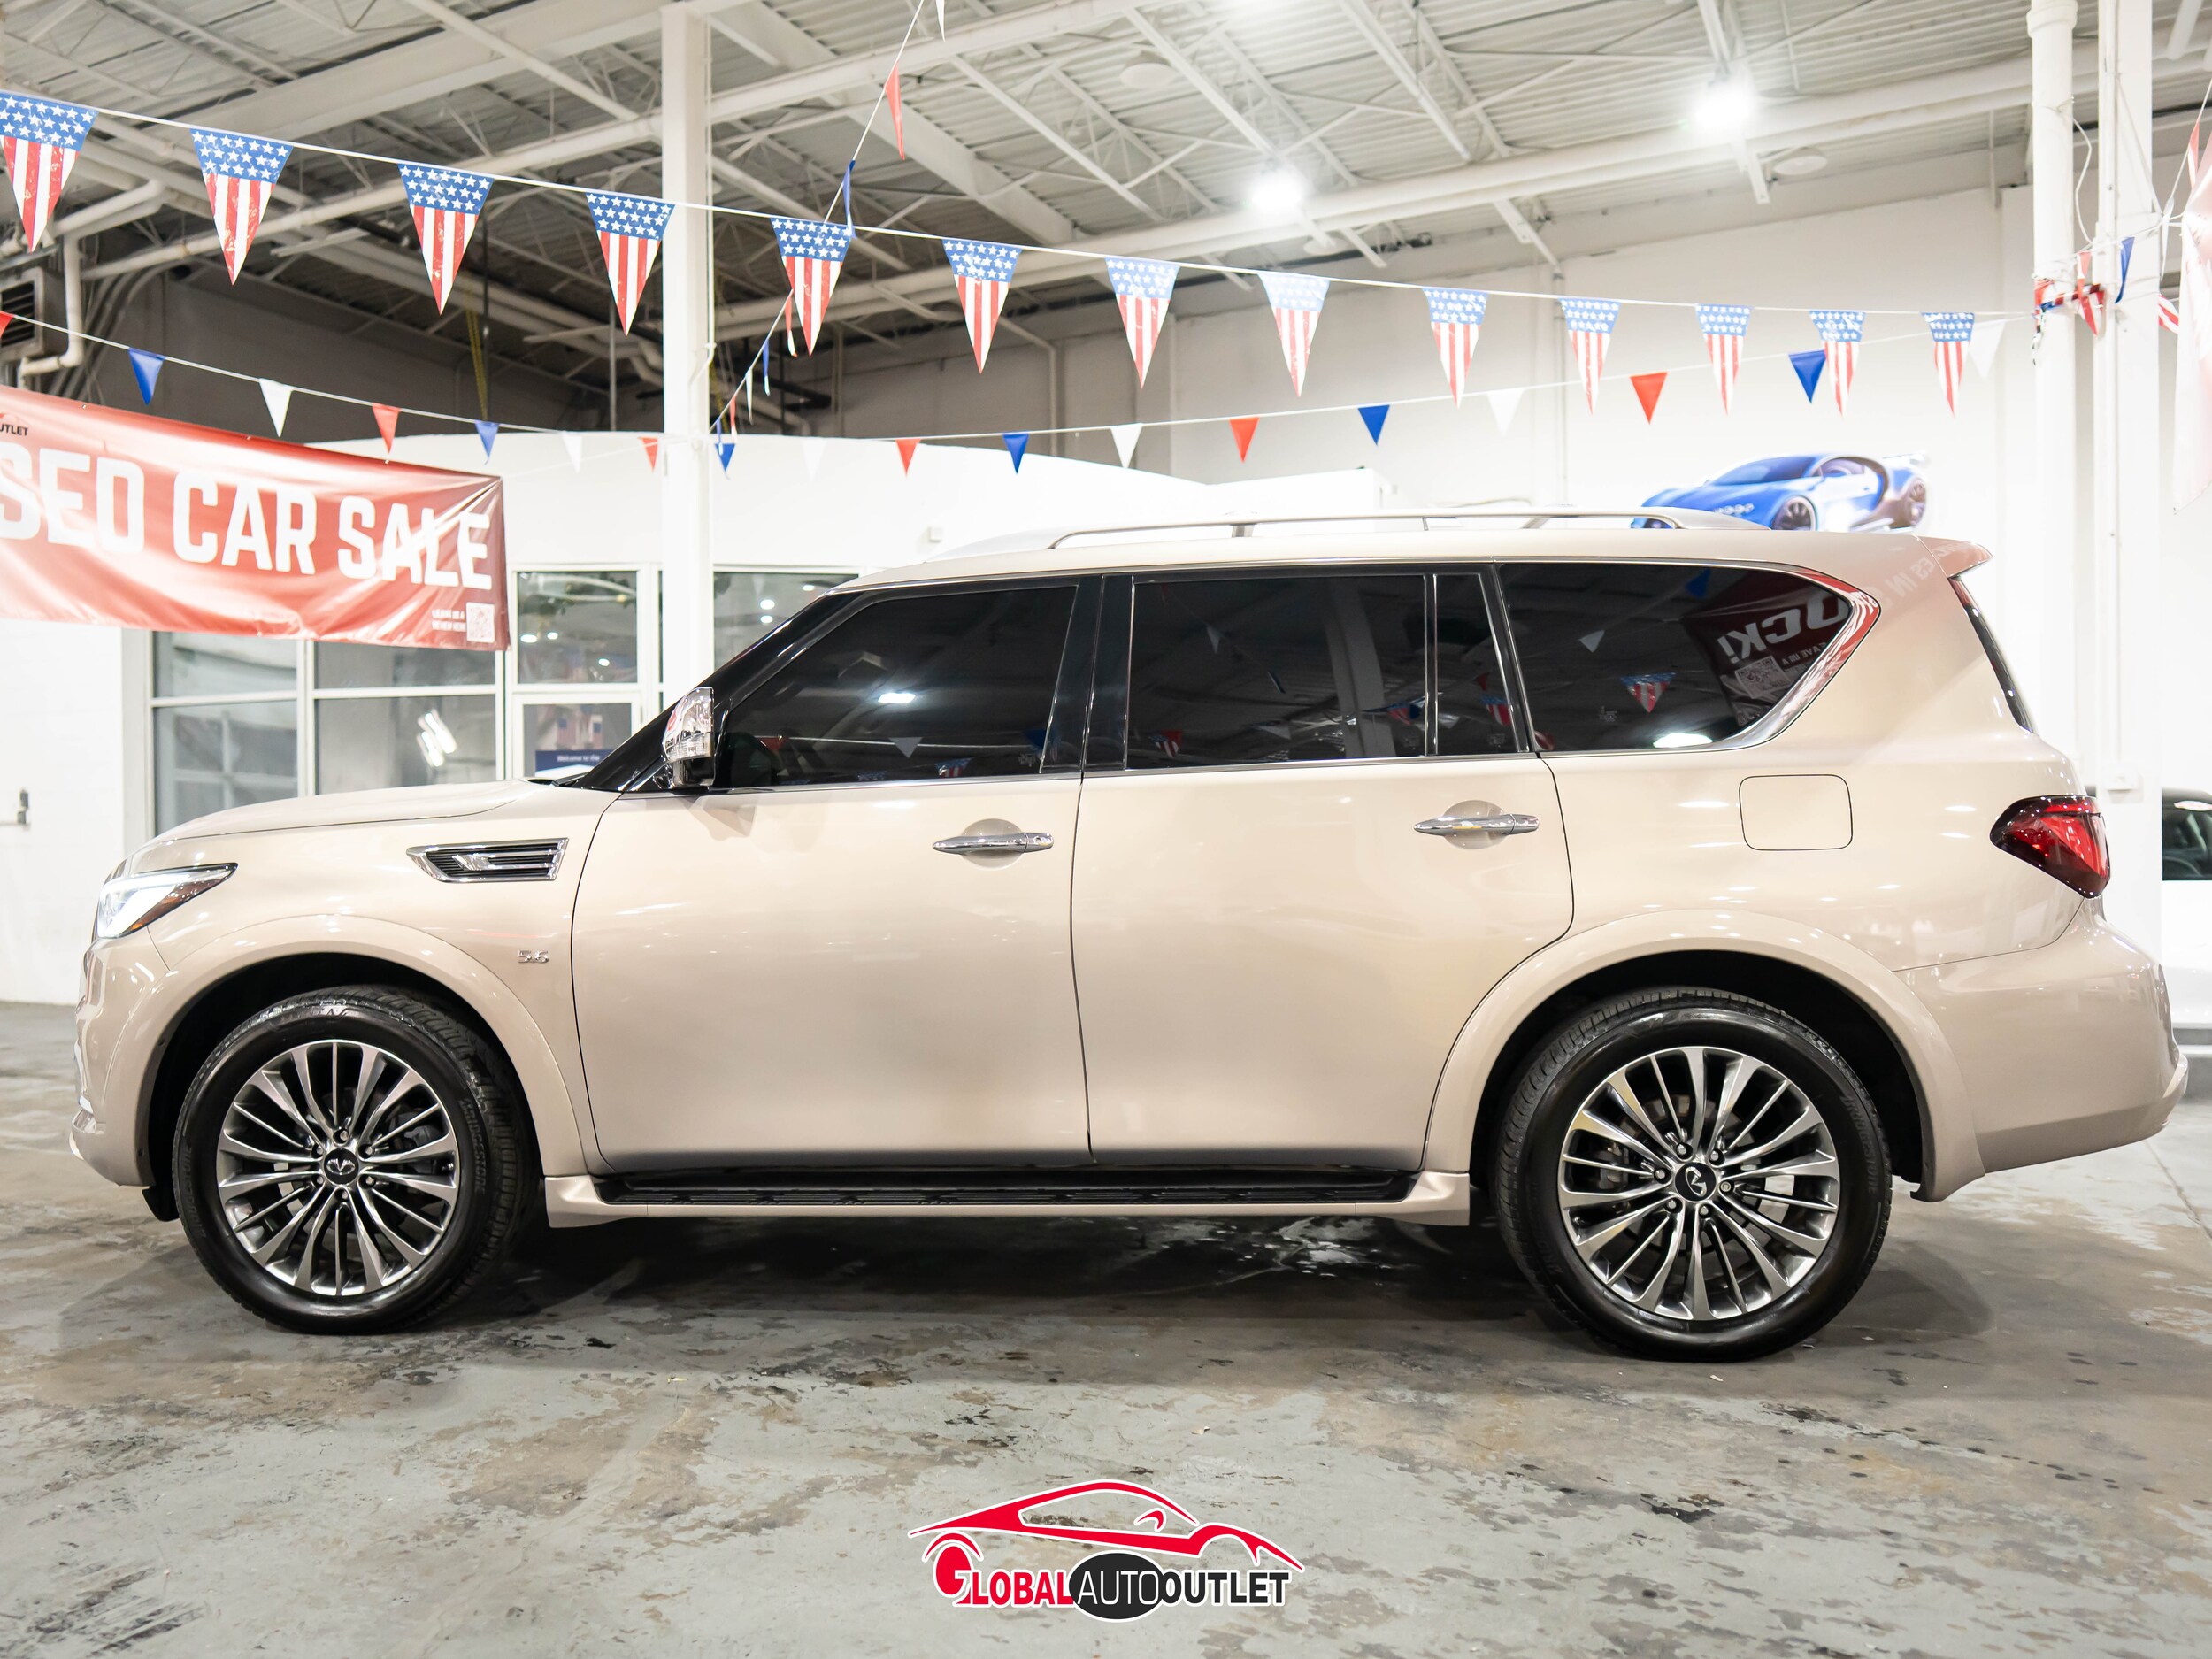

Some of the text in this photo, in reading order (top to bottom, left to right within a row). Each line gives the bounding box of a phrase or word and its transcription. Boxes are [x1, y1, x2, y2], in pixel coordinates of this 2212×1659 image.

[0, 440, 493, 590] SED CAR SALE
[518, 950, 549, 964] 5.6
[458, 1098, 487, 1195] BRIDGESTONE
